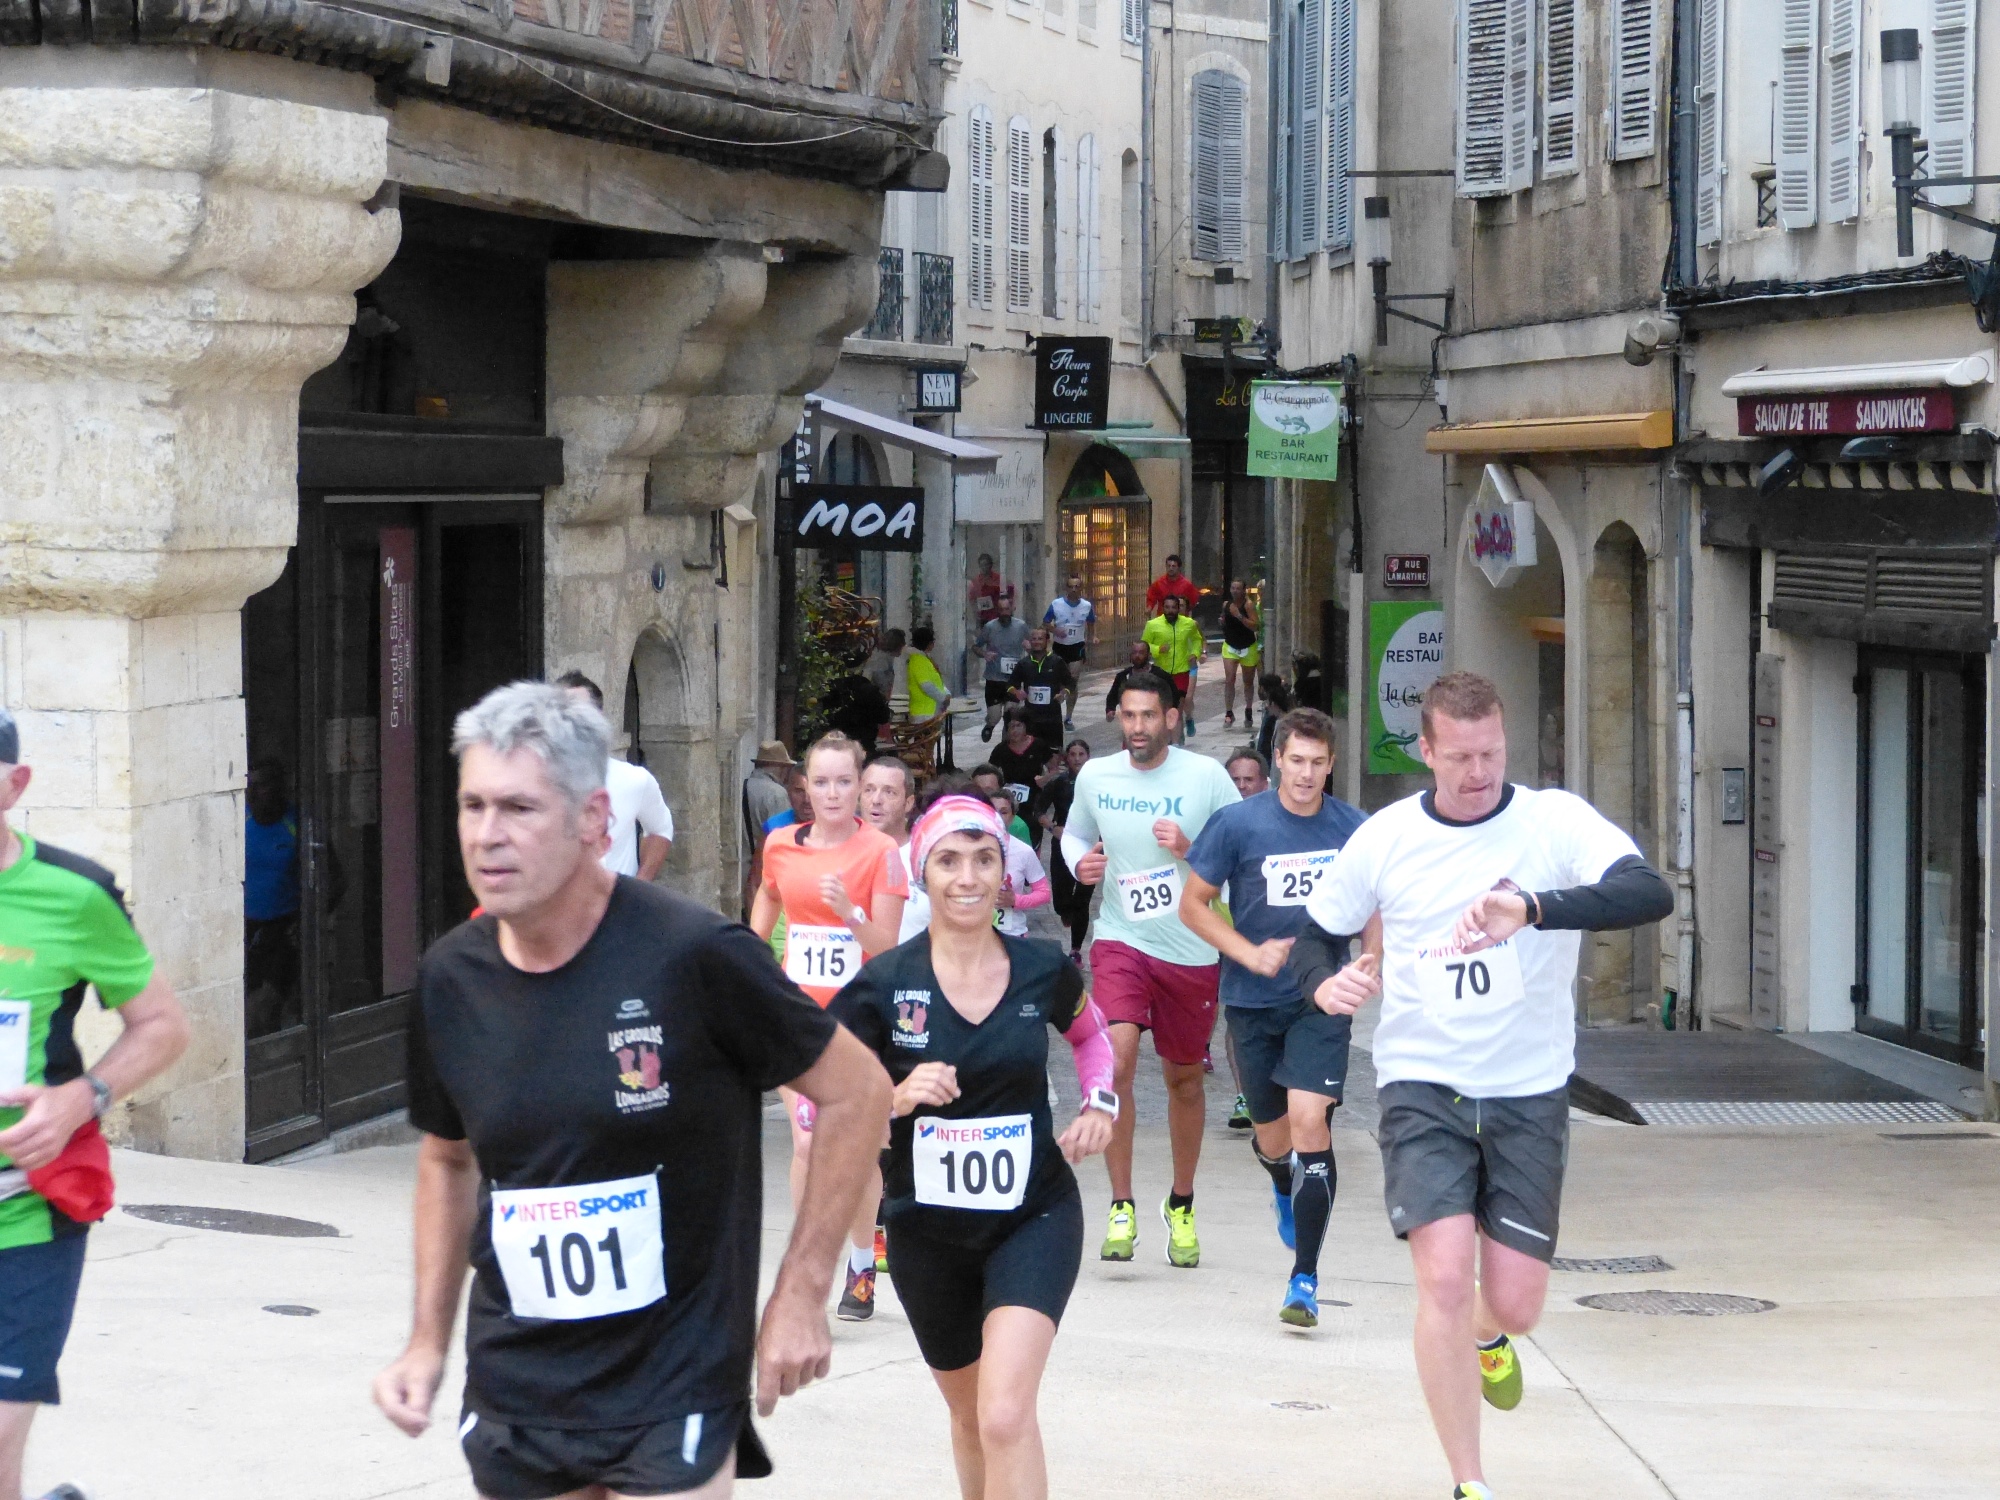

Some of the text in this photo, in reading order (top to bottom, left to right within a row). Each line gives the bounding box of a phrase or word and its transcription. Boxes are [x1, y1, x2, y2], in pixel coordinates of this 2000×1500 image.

[1049, 348, 1091, 370] Fleurs
[926, 375, 951, 389] NEW
[1052, 374, 1088, 402] Corps
[925, 392, 954, 407] STYL
[1044, 412, 1092, 424] LINGERIE
[1754, 396, 1926, 432] SALON DE THE SANDWICHS
[1281, 438, 1305, 449] BAR
[1255, 450, 1329, 463] RESTAURANT
[798, 500, 916, 539] MOA
[1404, 560, 1421, 569] RUE
[1387, 572, 1427, 581] LAMARTINE
[390, 584, 399, 728] Grands Sites
[1386, 649, 1443, 663] RESTAU
[1034, 692, 1044, 702] 79
[1098, 793, 1161, 815] Hurley
[1279, 855, 1335, 868] INTERSPORT
[1126, 868, 1175, 885] INTERSPORT
[1130, 883, 1173, 914] 239
[804, 946, 845, 977] 115
[1445, 960, 1490, 1000] 70
[936, 1124, 1027, 1143] INTERSPORT
[939, 1149, 1015, 1195] 100
[518, 1188, 649, 1222] INTERSPORT
[530, 1226, 628, 1299] 101
